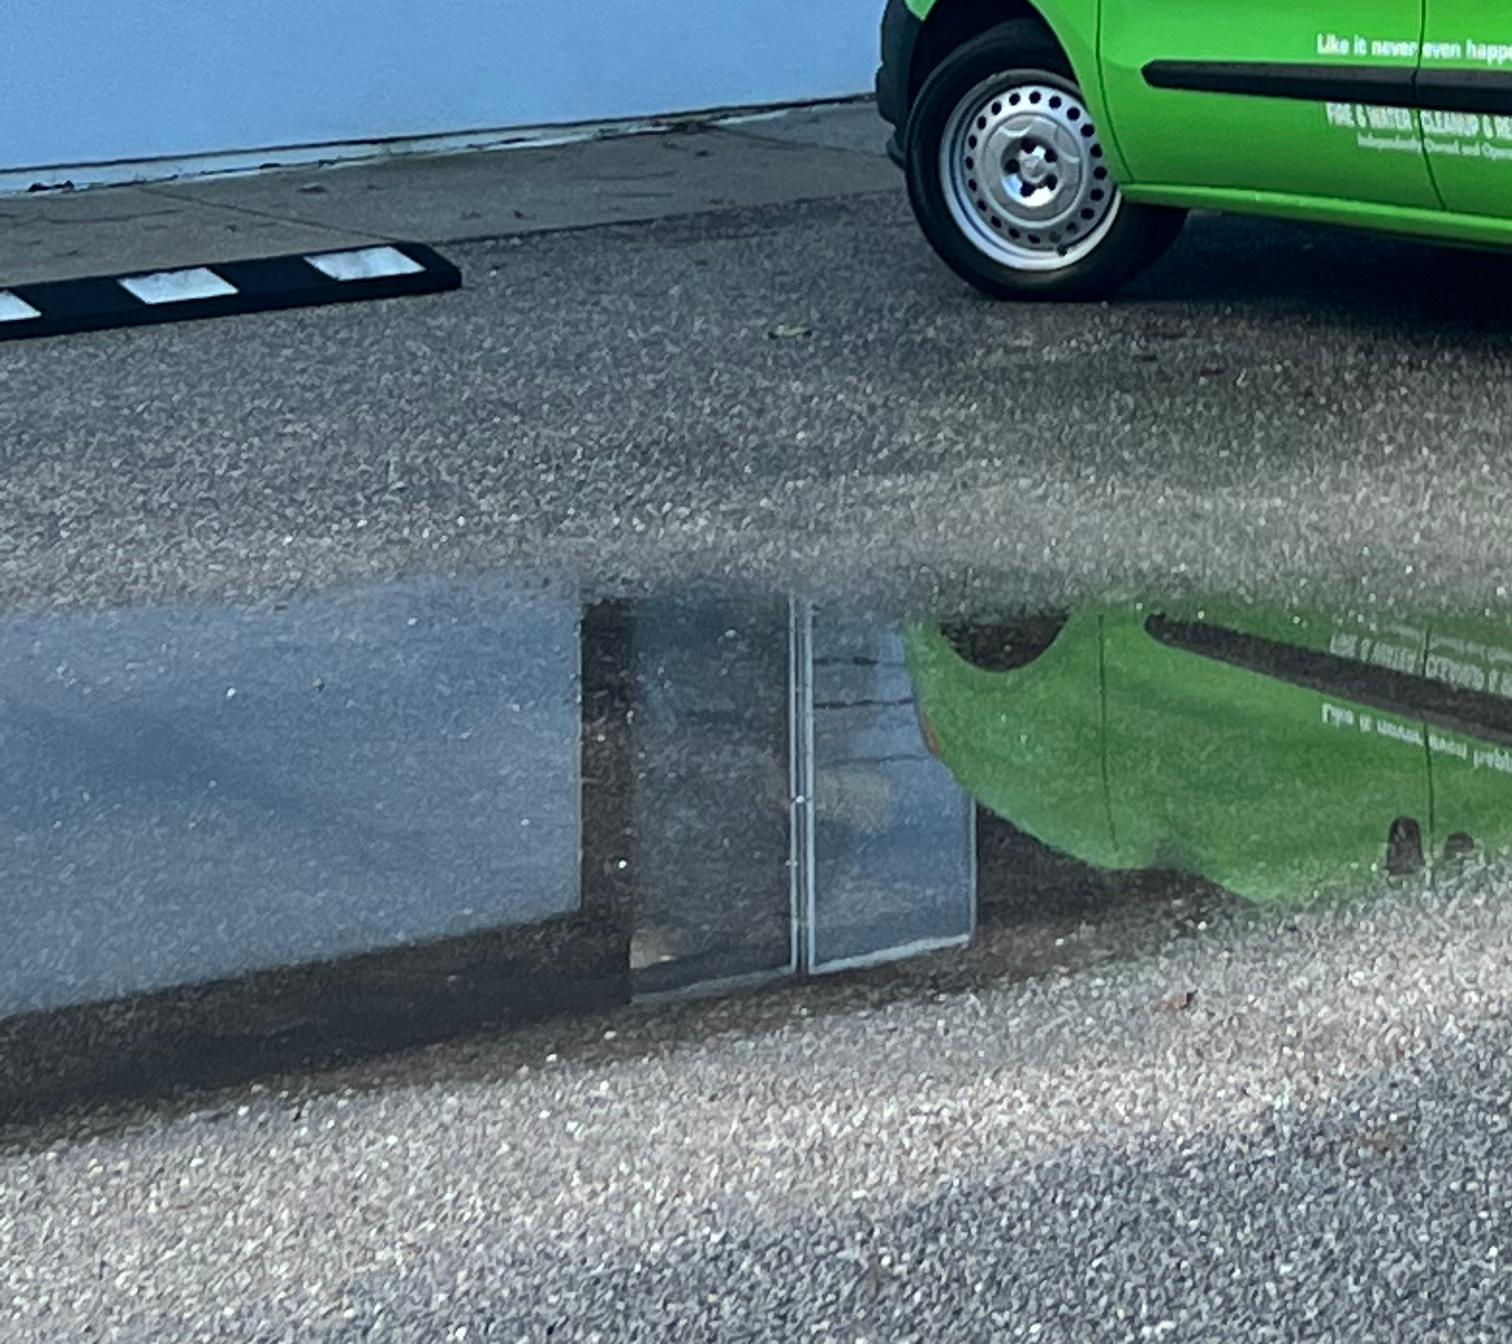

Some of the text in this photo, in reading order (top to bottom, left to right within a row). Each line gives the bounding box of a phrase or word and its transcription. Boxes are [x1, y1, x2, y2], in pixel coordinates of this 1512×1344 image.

[1316, 33, 1350, 56] Like
[1353, 34, 1367, 56] it
[1371, 39, 1418, 58] never
[1422, 42, 1461, 59] even
[1419, 110, 1480, 137] CLEANUP
